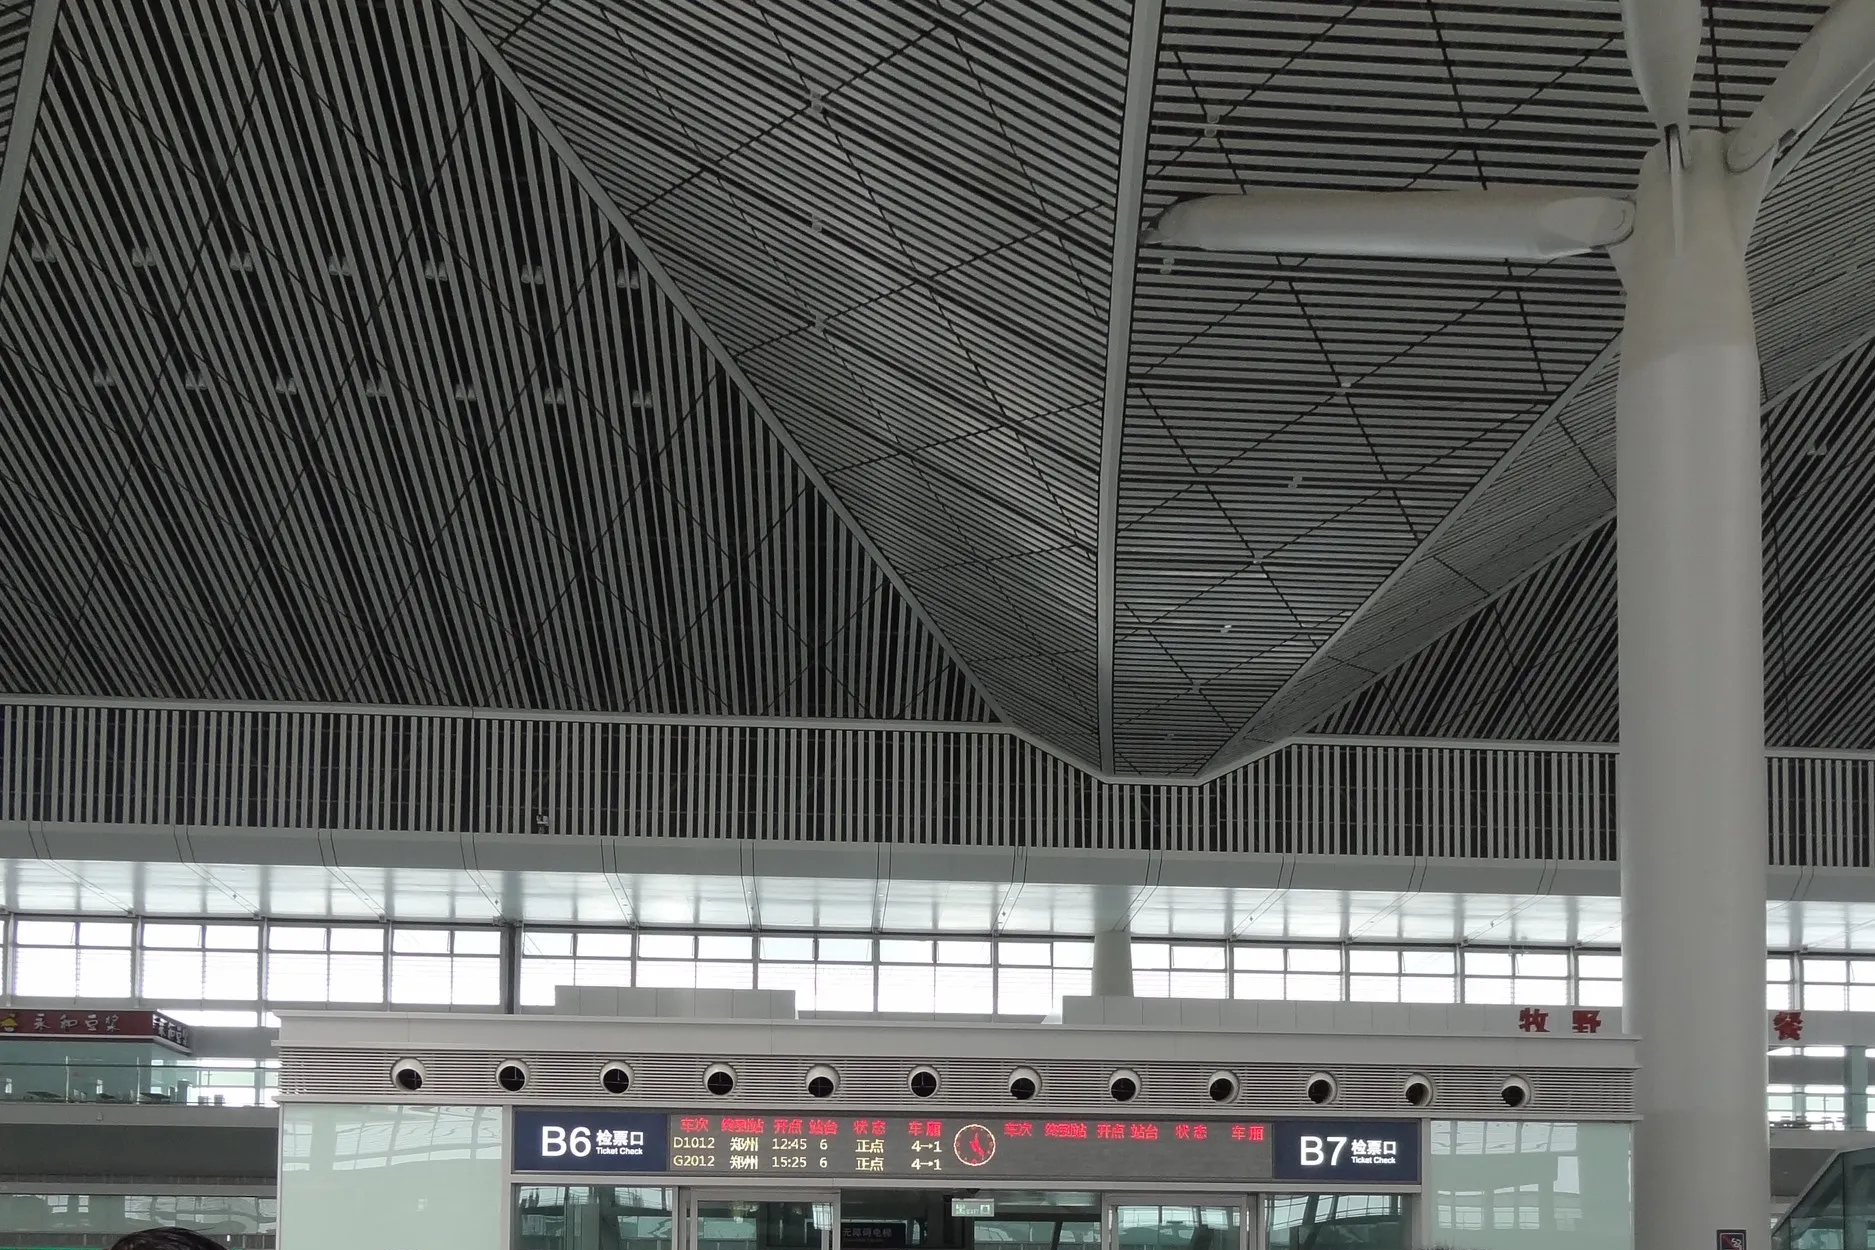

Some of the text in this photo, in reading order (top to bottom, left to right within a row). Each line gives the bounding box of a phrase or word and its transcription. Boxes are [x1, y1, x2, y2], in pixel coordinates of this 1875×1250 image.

[680, 1117, 709, 1132] 车次
[773, 1119, 803, 1134] 开点
[809, 1119, 838, 1135] 站台
[853, 1120, 886, 1135] 状态
[908, 1121, 943, 1136] 车厢
[1004, 1122, 1033, 1137] 车次
[1097, 1123, 1126, 1139] 开点
[1130, 1124, 1160, 1140] 站台
[1175, 1124, 1208, 1140] 状态
[1231, 1125, 1265, 1141] 车厢
[541, 1125, 592, 1157] B6
[595, 1129, 644, 1146] 检票口
[673, 1137, 715, 1149] D1012
[730, 1137, 759, 1151] 郑州
[771, 1138, 808, 1150] 12:45
[819, 1138, 828, 1150] 6
[855, 1139, 885, 1153] 正点
[595, 1147, 643, 1155] Ticket Check
[1300, 1135, 1348, 1166] B7
[1350, 1138, 1397, 1155] 检票口
[673, 1155, 715, 1167] G2012
[730, 1155, 759, 1169] 郑州
[771, 1156, 808, 1168] 15:25
[819, 1156, 828, 1168] 6
[855, 1157, 885, 1171] 正点
[1350, 1156, 1396, 1164] Ticket Check
